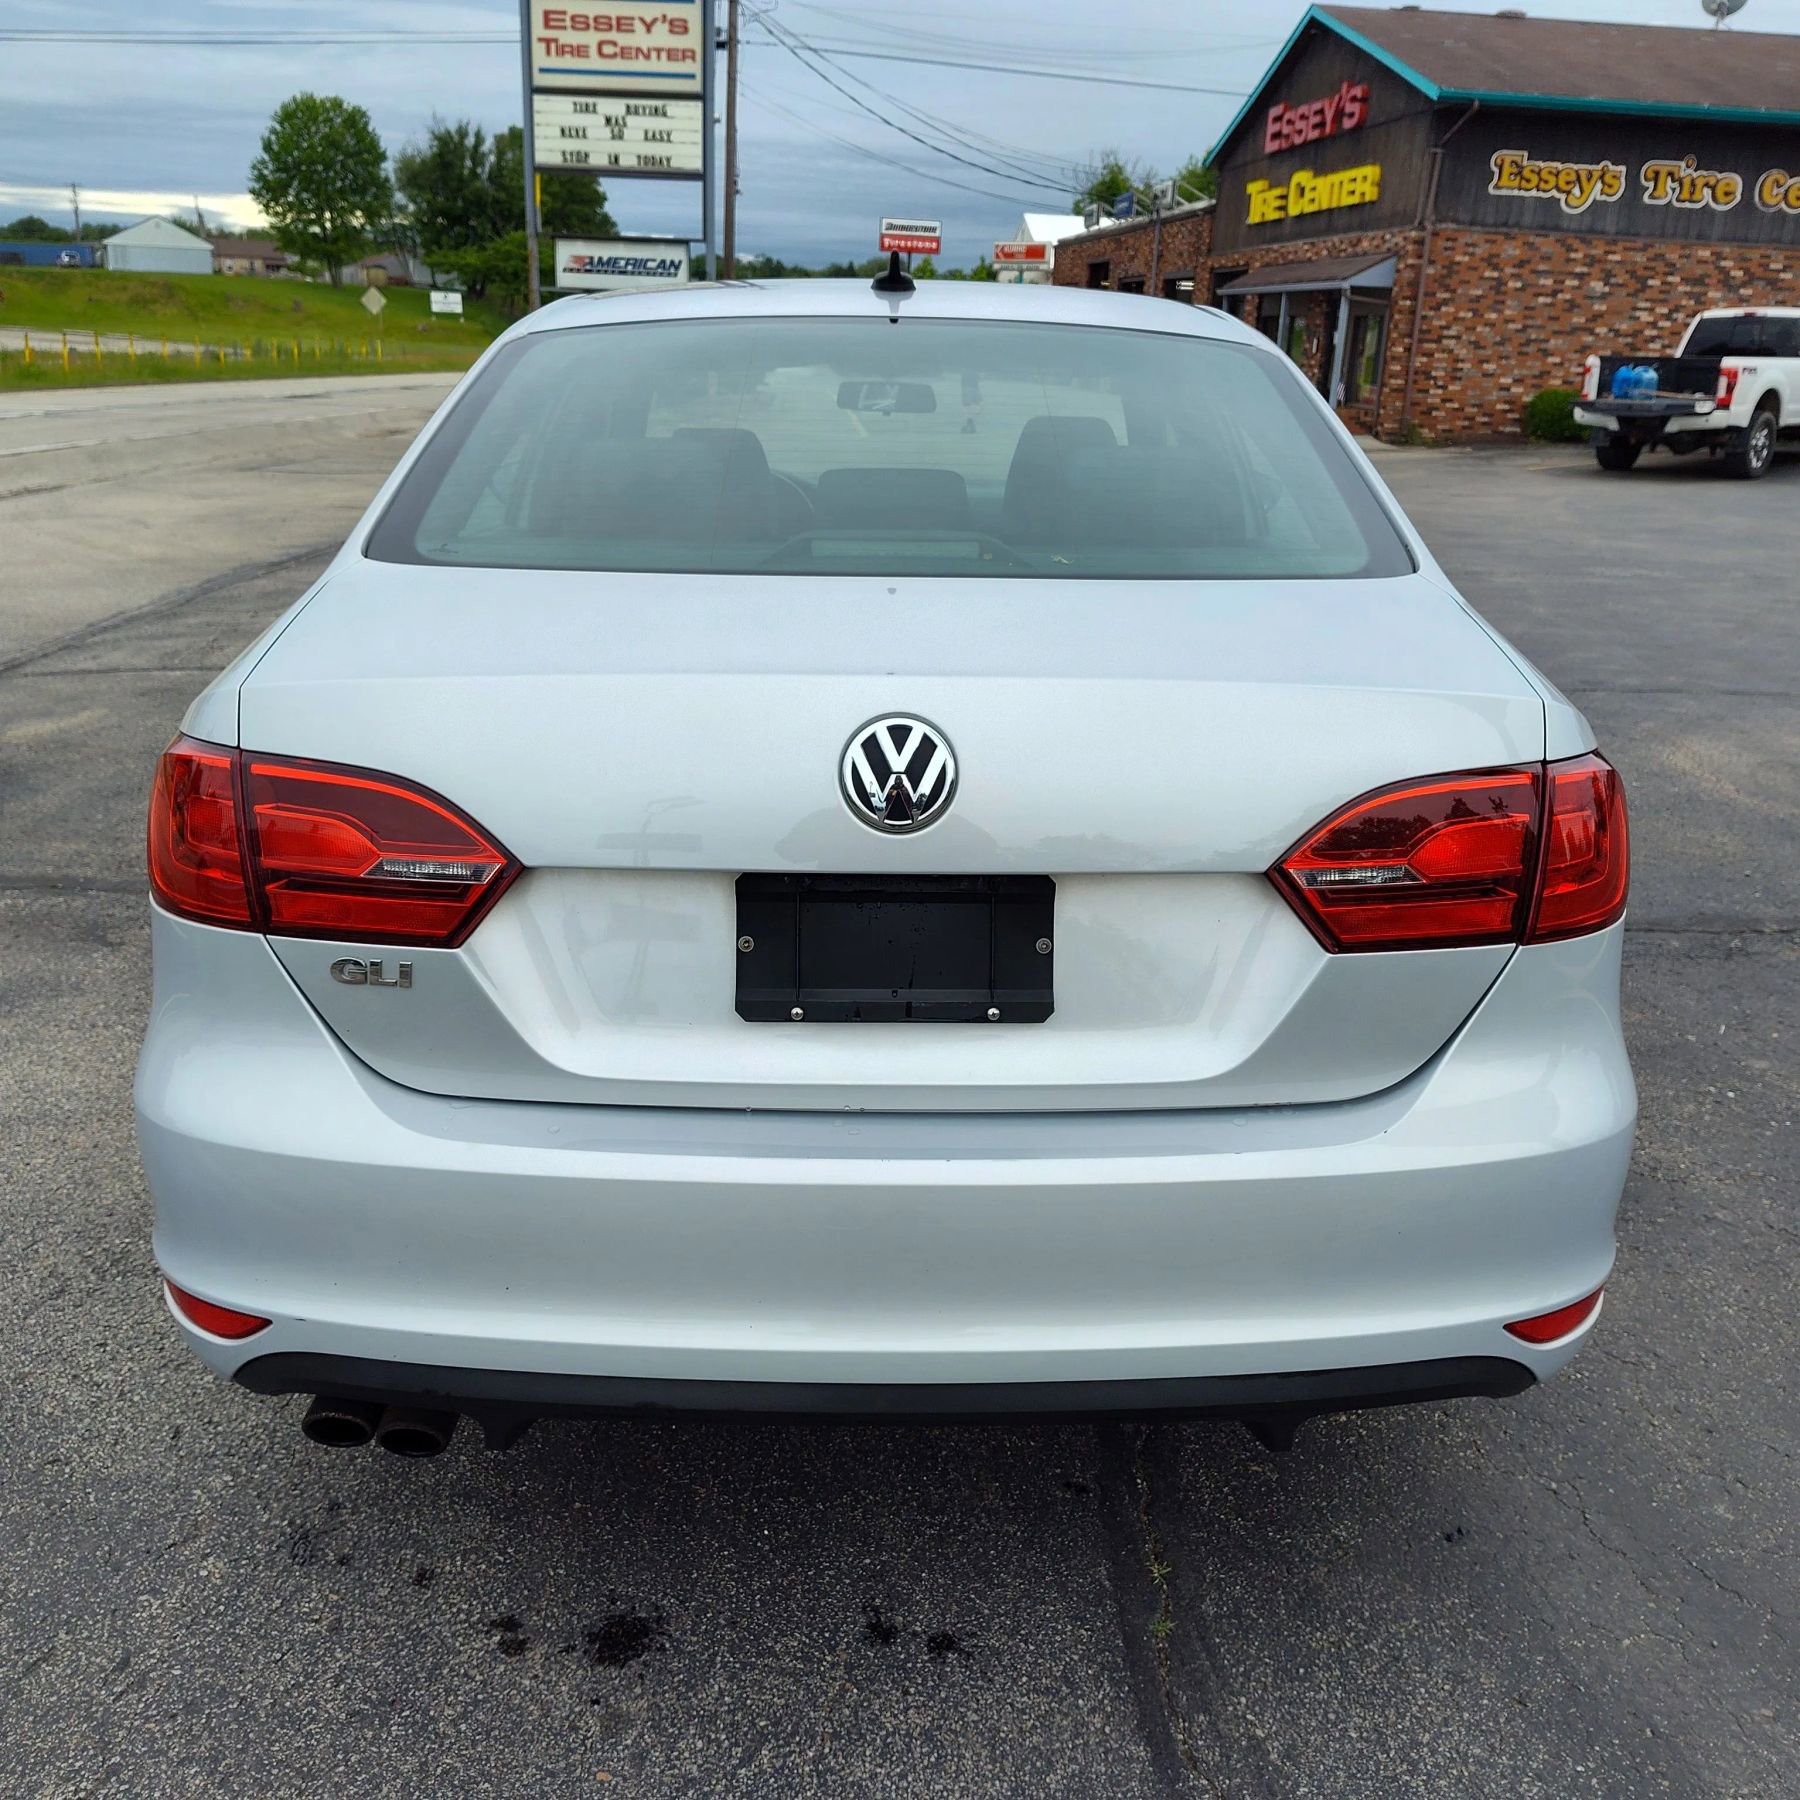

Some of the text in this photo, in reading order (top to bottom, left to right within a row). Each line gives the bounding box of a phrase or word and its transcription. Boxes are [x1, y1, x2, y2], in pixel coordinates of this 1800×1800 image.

[543, 9, 690, 35] ESSEY'S
[537, 37, 697, 63] TIRE CENTER
[572, 101, 668, 117] TIRE BUYING
[604, 114, 627, 128] WAS
[1264, 81, 1369, 153] ESSEY'S
[610, 127, 625, 140] SO
[643, 129, 672, 143] EASY
[561, 150, 672, 168] STOP IN TODAY
[1287, 163, 1382, 217] CENTER
[1490, 150, 1626, 213] Essey's
[1641, 154, 1742, 211] Tire
[583, 255, 683, 272] AMERICAN
[330, 956, 413, 988] GLI
